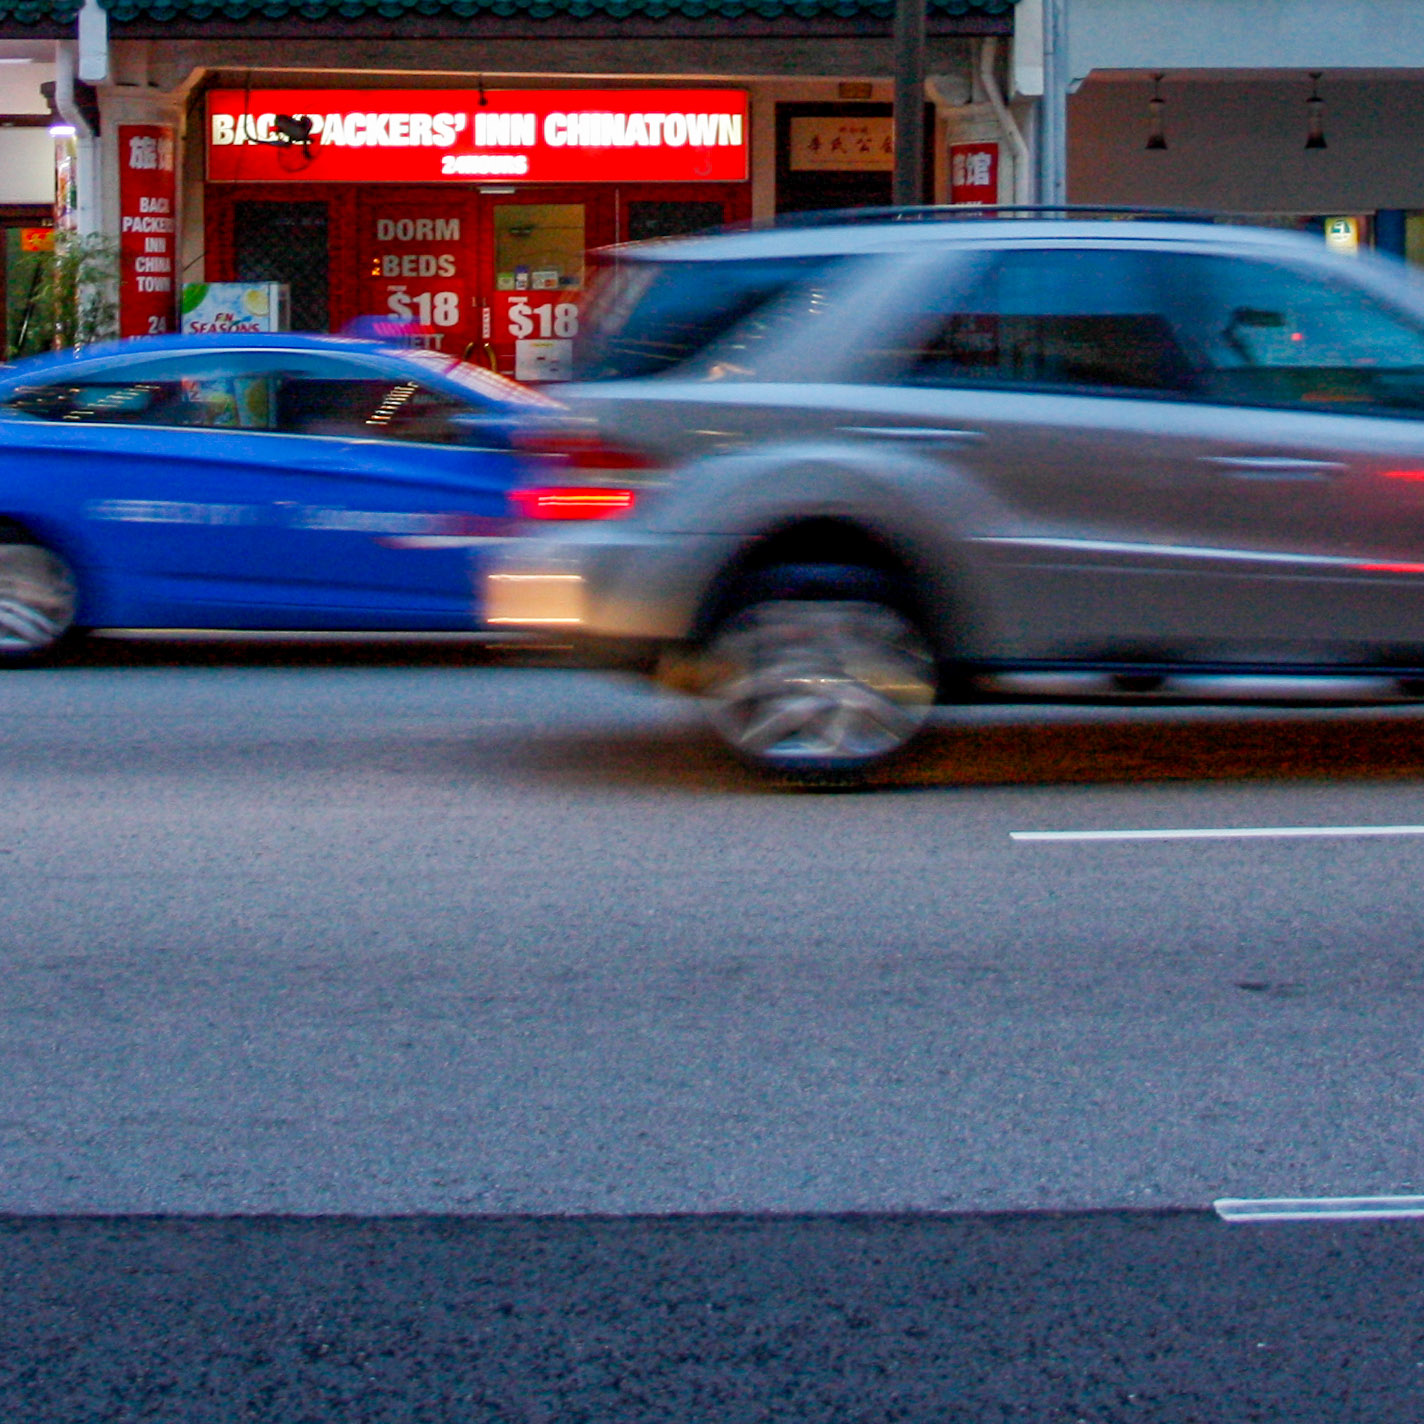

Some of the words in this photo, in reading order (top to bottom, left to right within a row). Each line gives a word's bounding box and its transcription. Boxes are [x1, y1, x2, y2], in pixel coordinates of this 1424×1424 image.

[212, 113, 466, 146] BACPACKERS'
[474, 112, 536, 146] INN
[544, 112, 742, 147] CHINATOWN
[377, 218, 460, 241] DORM
[382, 255, 456, 277] BEDS
[387, 291, 459, 327] $18
[508, 301, 579, 340] $18
